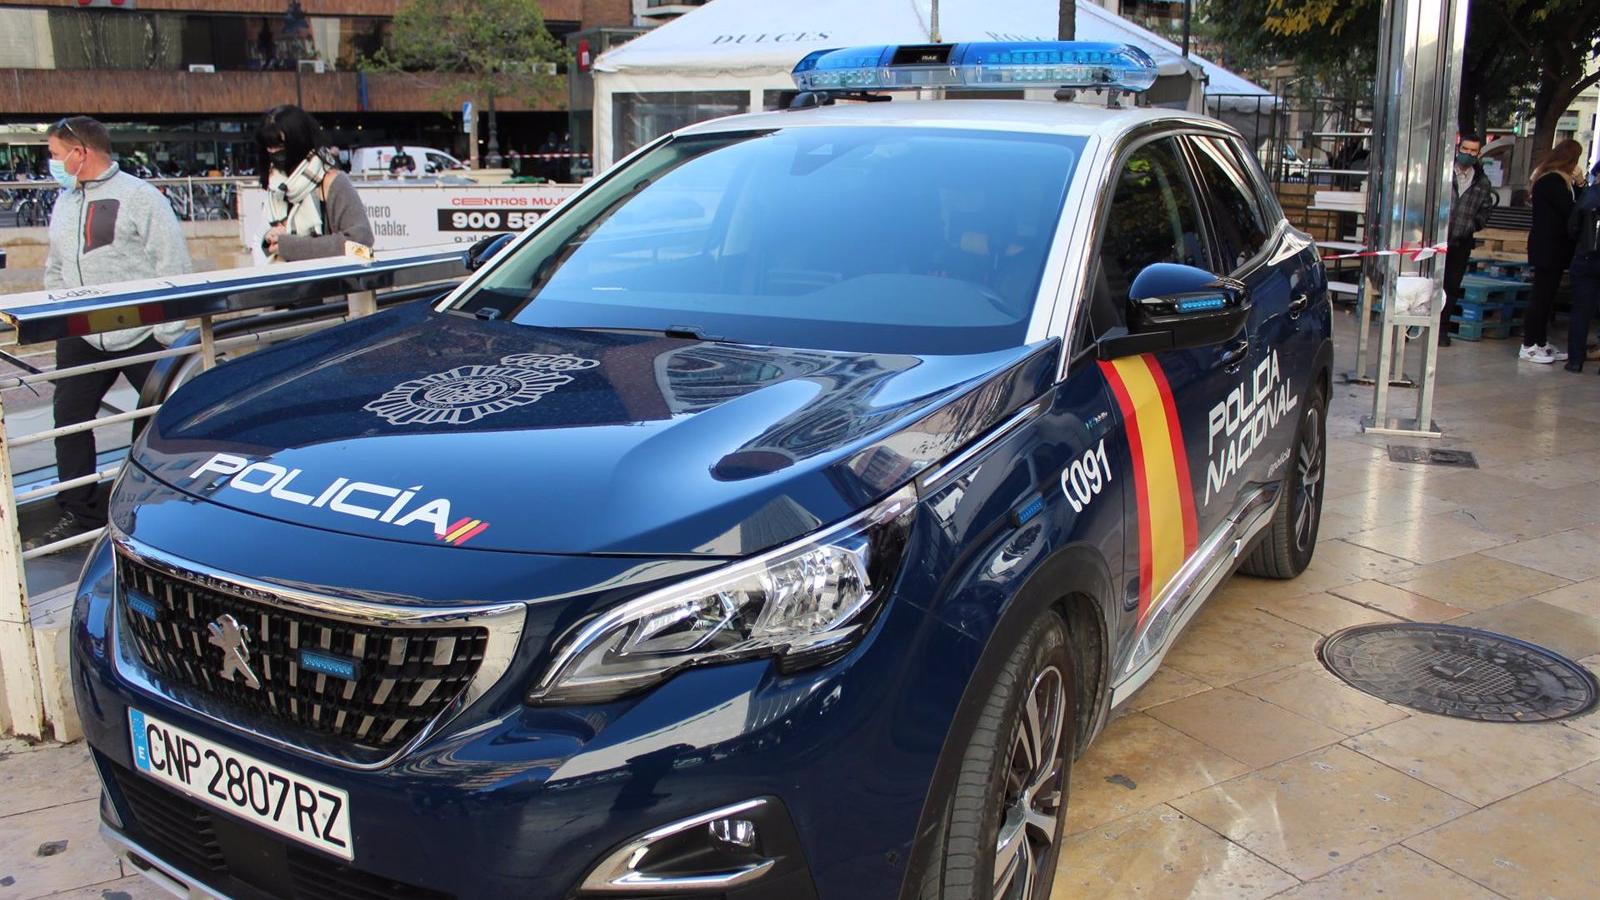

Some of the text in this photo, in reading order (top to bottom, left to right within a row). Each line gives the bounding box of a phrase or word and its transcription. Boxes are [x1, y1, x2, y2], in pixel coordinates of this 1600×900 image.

[712, 32, 831, 45] DULCES
[452, 197, 527, 206] CENTROS
[374, 220, 410, 237] hablar.
[452, 212, 500, 229] 900
[1208, 345, 1281, 456] POLICÍA
[1204, 377, 1298, 507] NACIONAL
[189, 453, 451, 535] POLICÍA
[186, 571, 268, 598] PEUGEOT
[137, 746, 146, 760] E
